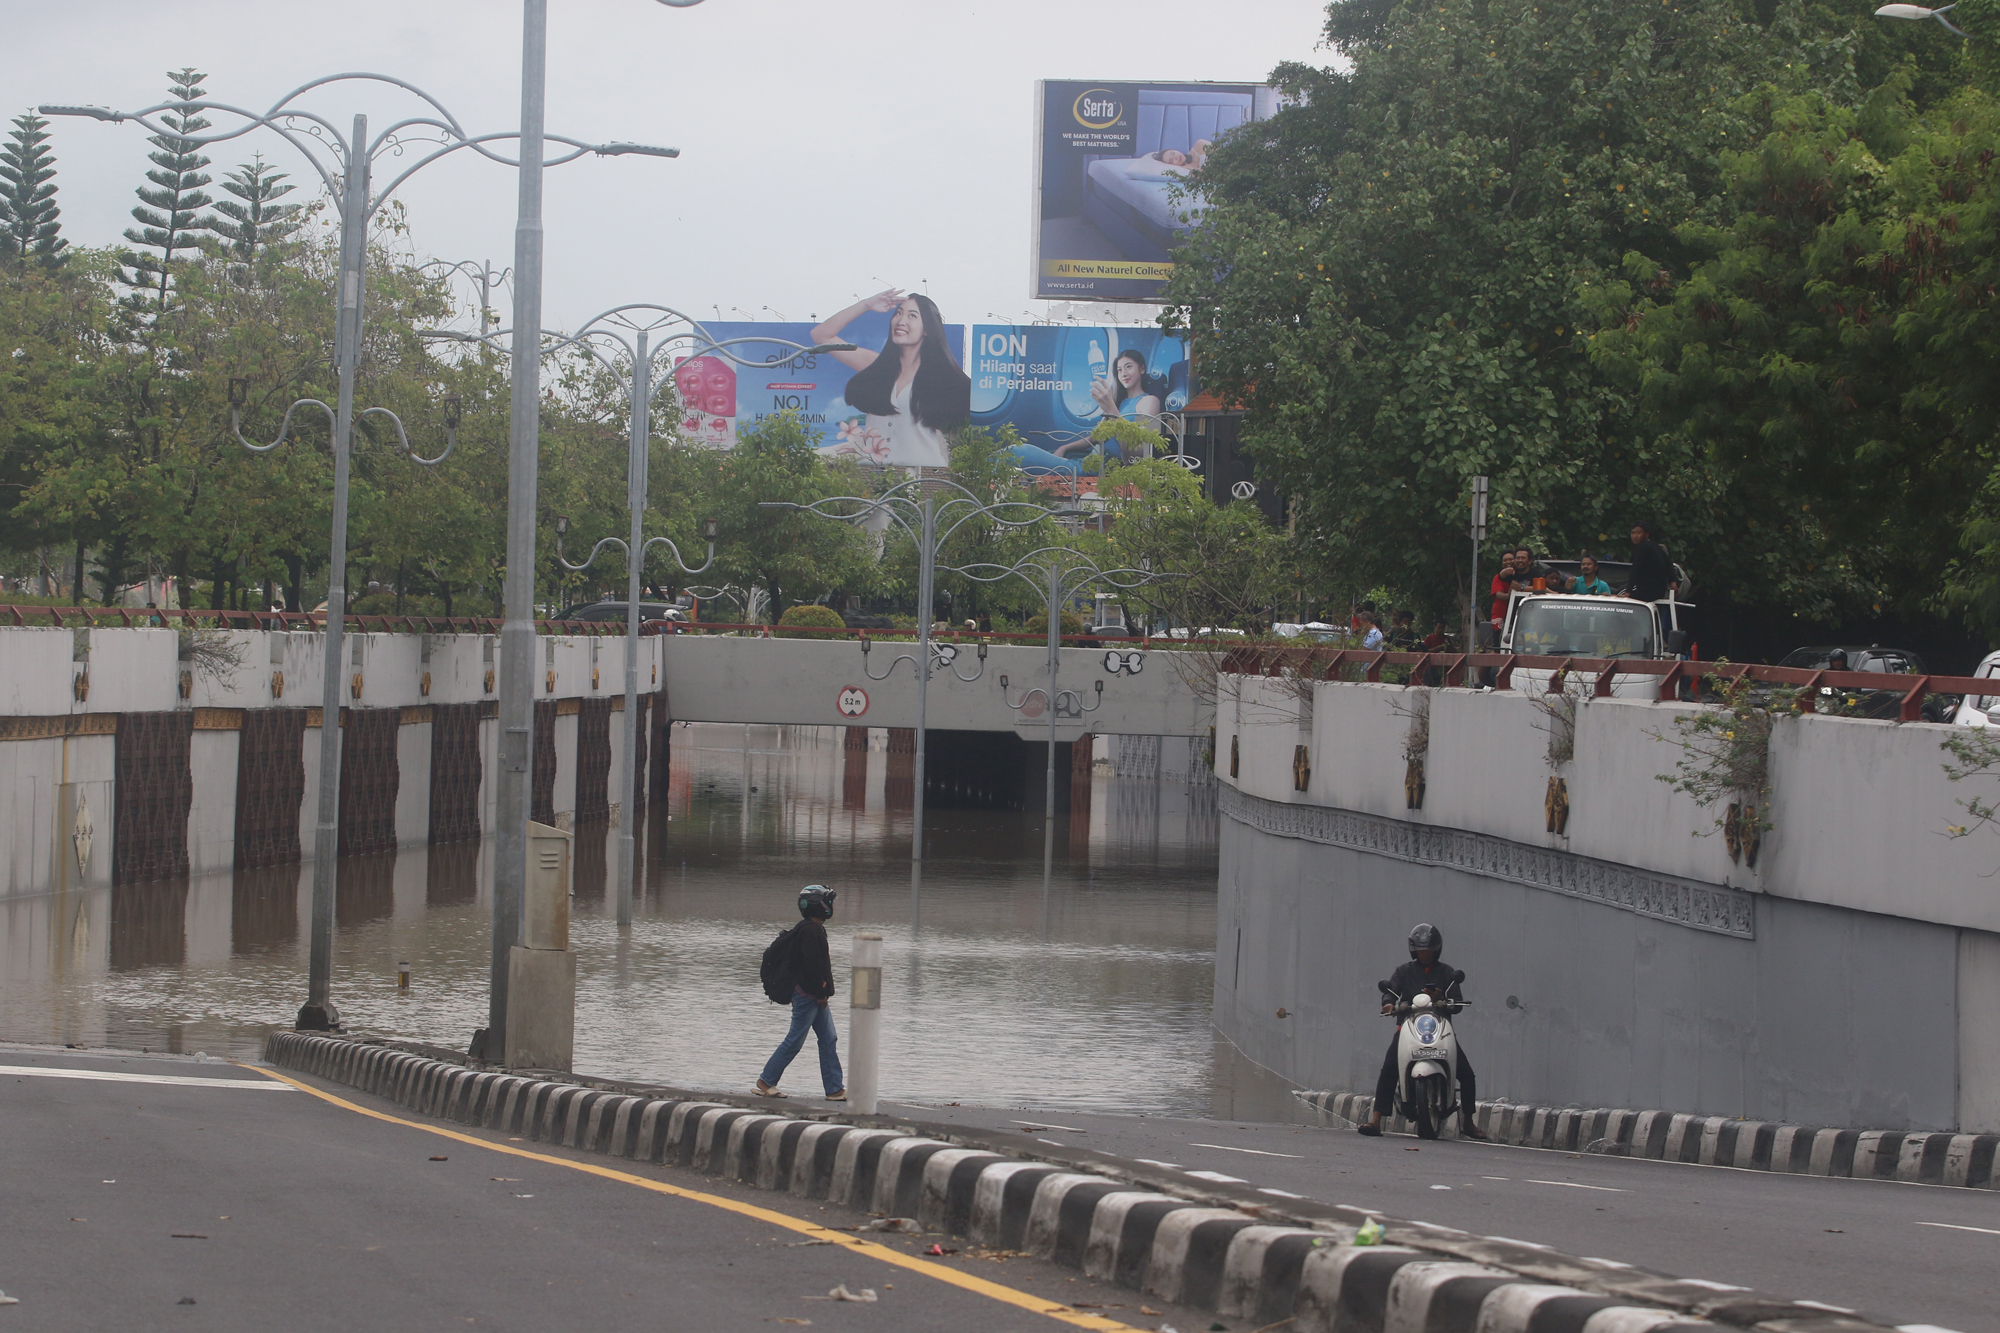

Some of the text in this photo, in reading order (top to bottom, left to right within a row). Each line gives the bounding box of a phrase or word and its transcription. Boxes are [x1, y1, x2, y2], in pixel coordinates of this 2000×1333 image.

[1083, 98, 1114, 117] Serta
[1057, 264, 1070, 272] All
[1073, 265, 1094, 273] New
[1097, 265, 1133, 274] Naturel
[980, 333, 1027, 357] ION
[980, 359, 1057, 376] Hilang saat
[979, 376, 1073, 393] di Perjalanan
[844, 697, 854, 705] 5.2
